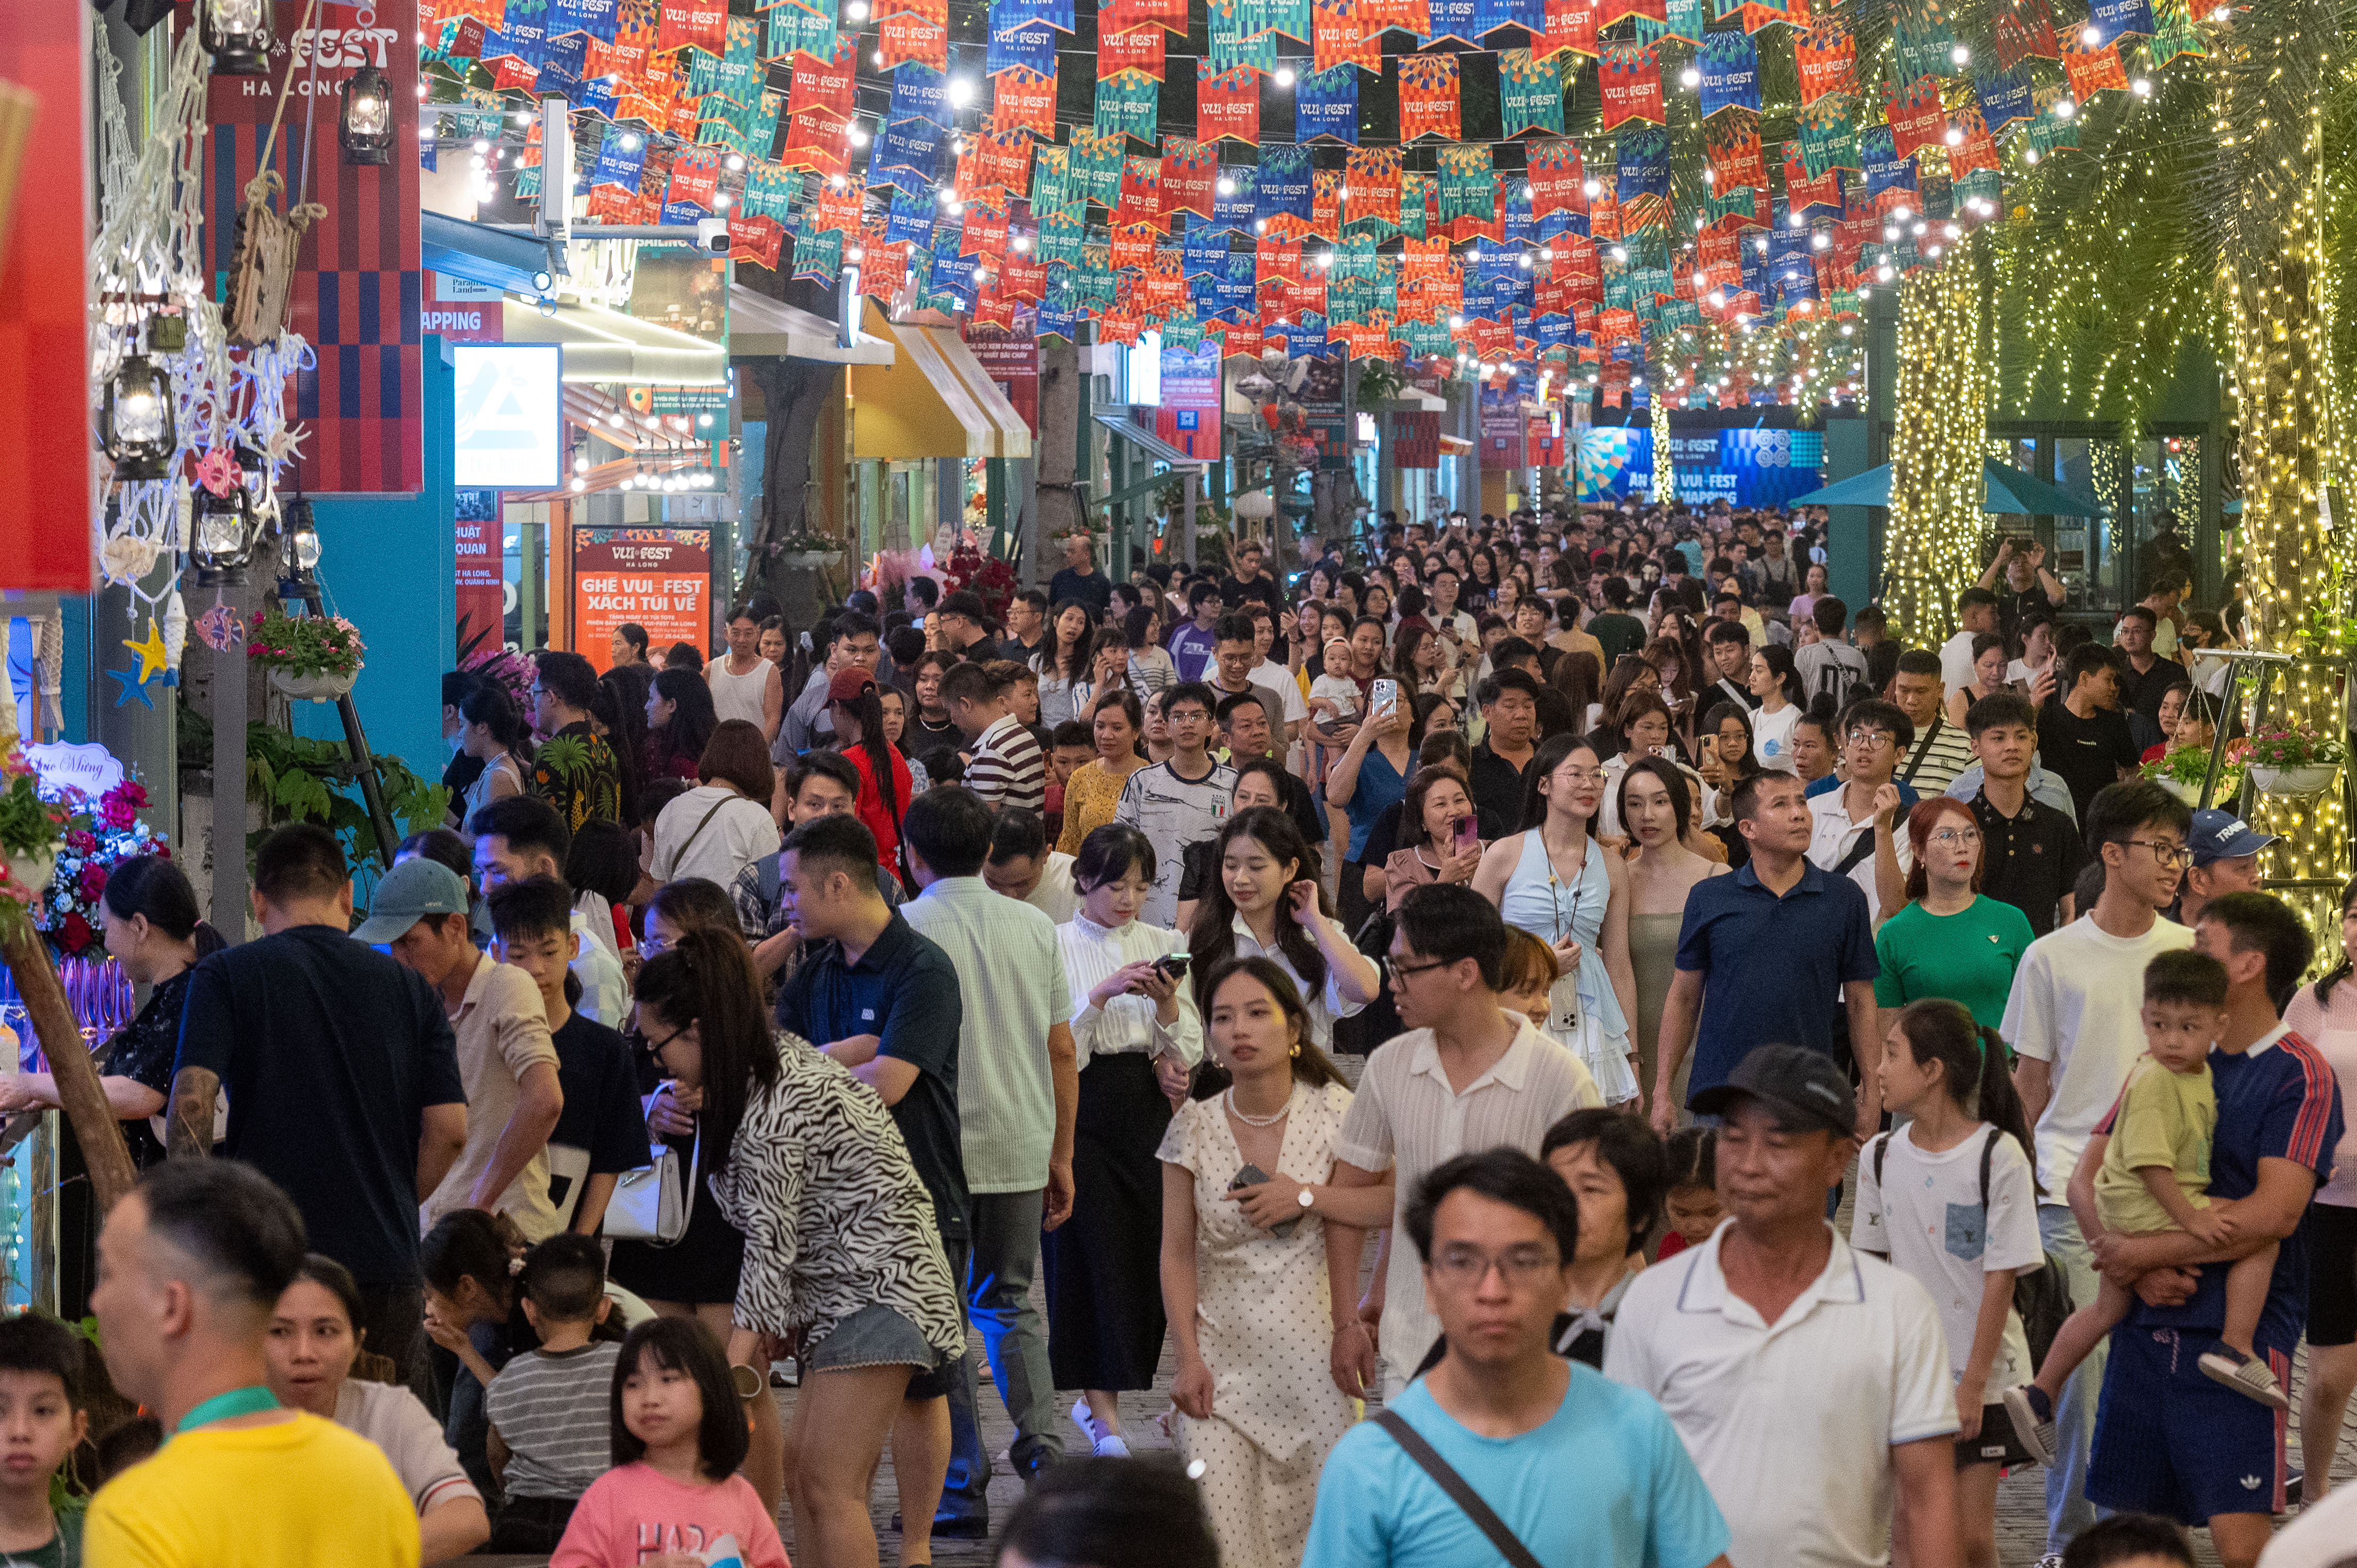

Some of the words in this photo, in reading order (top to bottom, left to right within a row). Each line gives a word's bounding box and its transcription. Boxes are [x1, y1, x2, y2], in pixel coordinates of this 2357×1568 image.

[291, 28, 398, 68] FEST
[244, 82, 272, 95] HA
[455, 543, 487, 555] QUAN
[612, 547, 635, 559] VUI
[640, 547, 673, 559] FEST
[581, 576, 617, 592] GHÉ
[587, 594, 635, 610] XÁCH
[640, 595, 668, 611] TÚI
